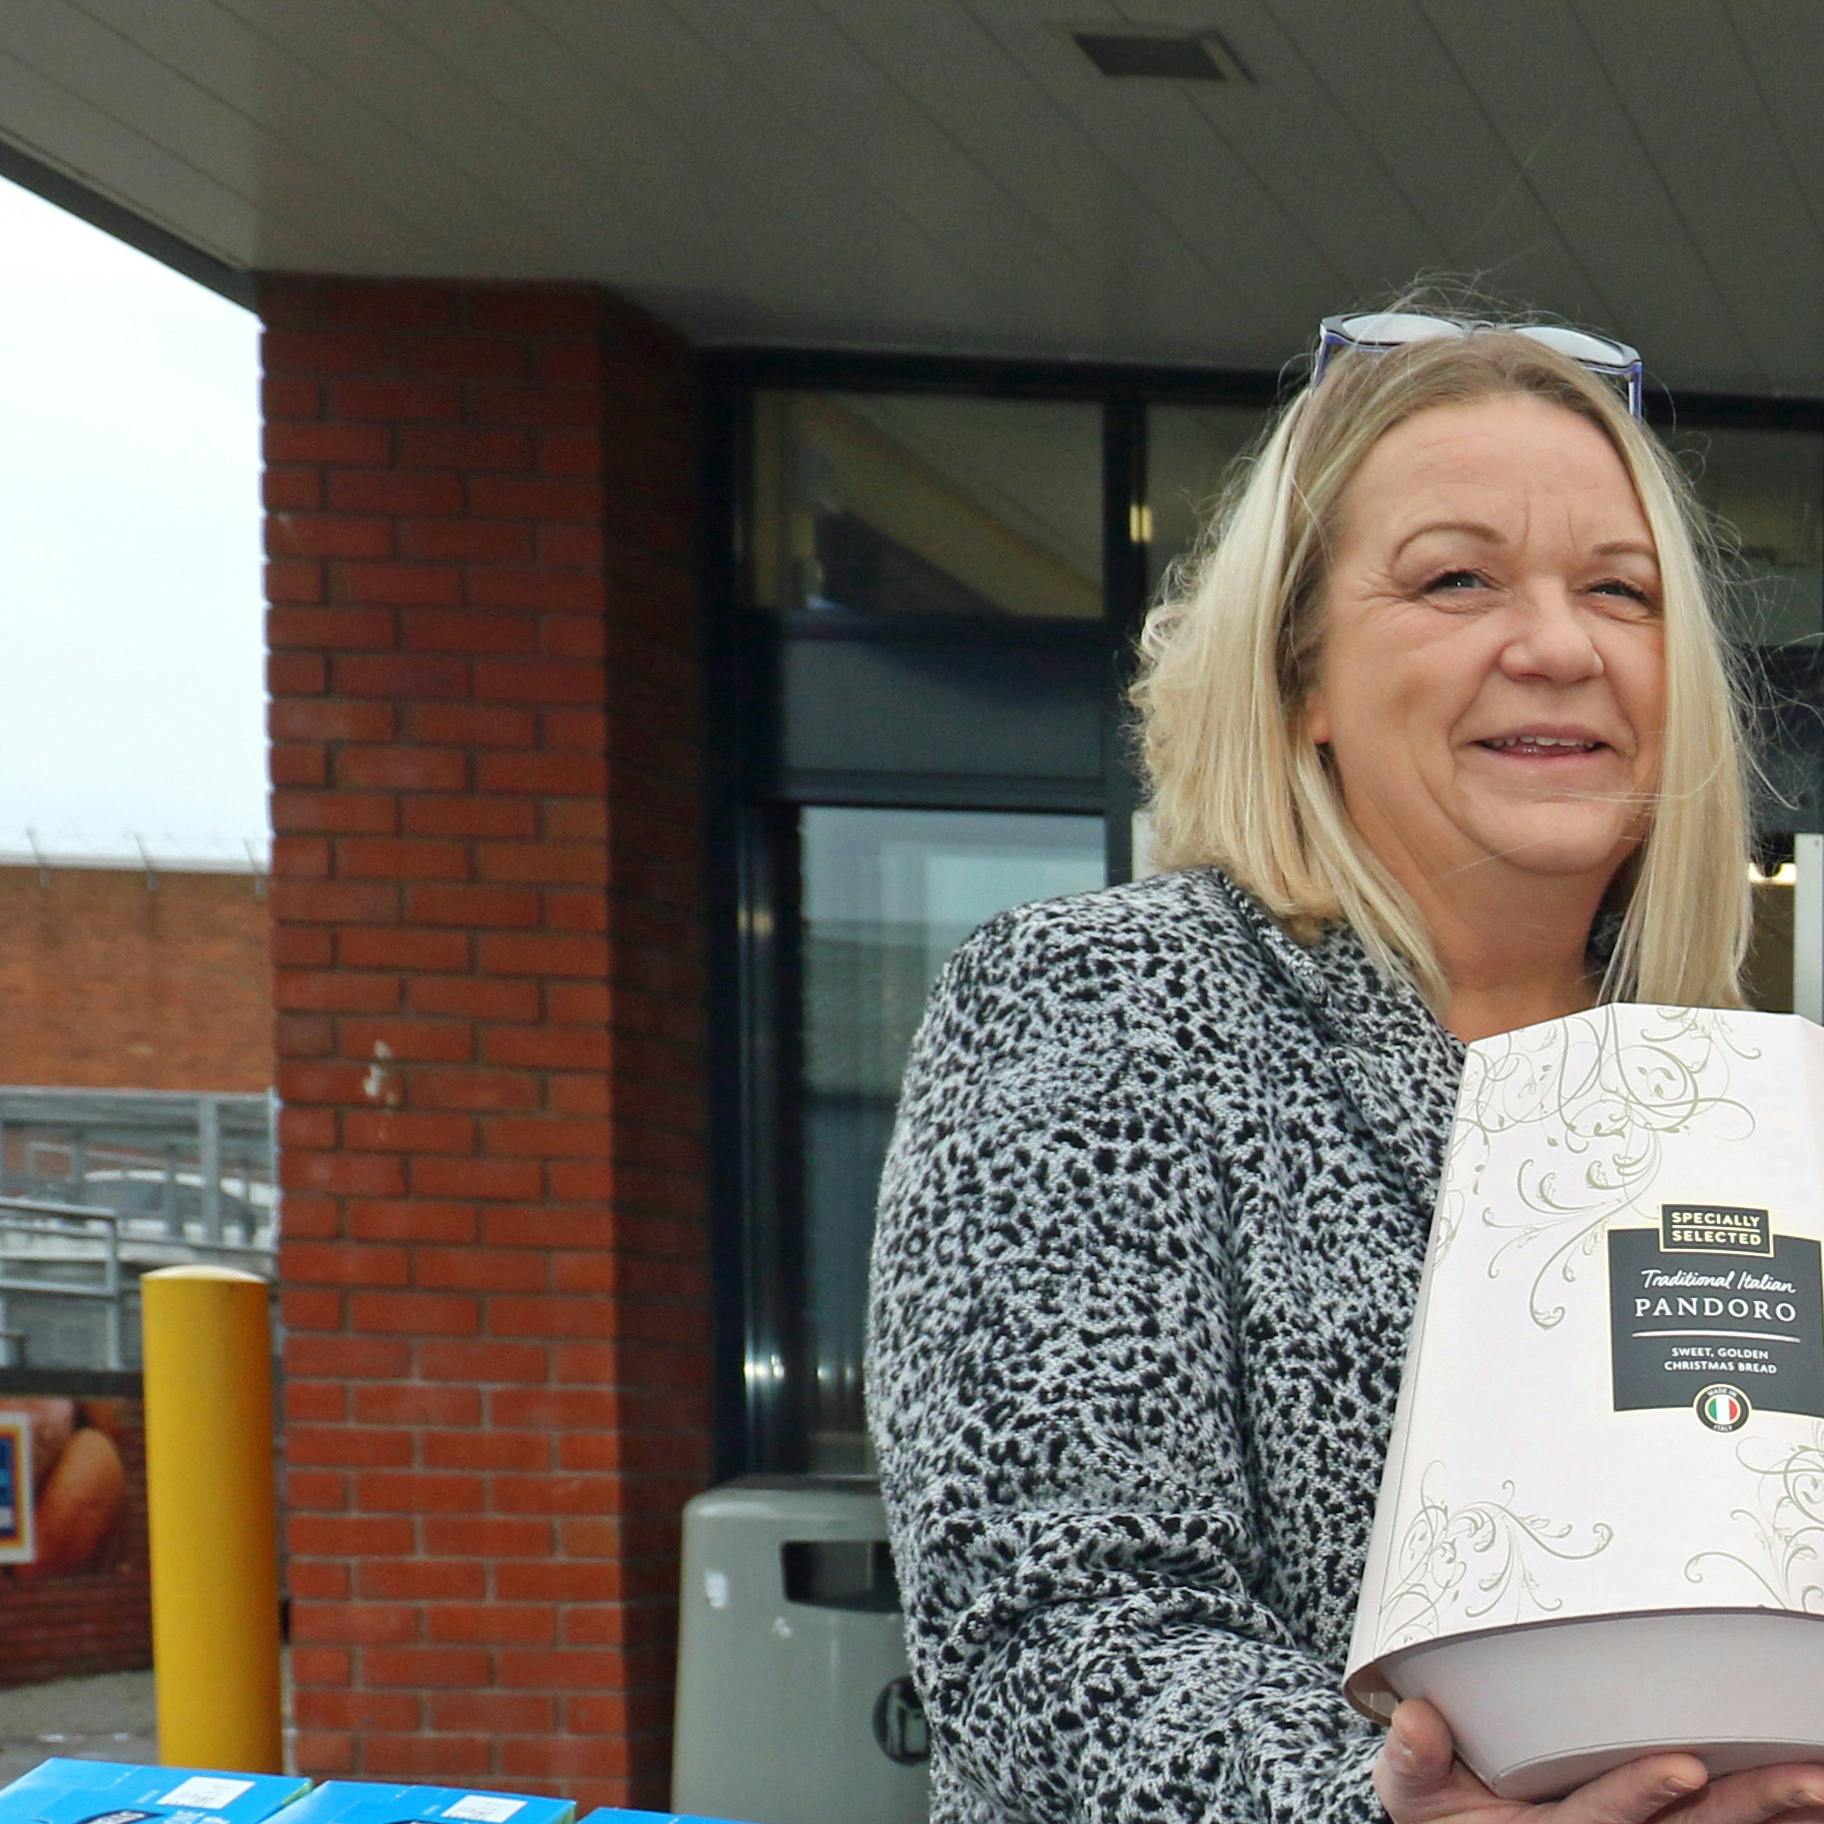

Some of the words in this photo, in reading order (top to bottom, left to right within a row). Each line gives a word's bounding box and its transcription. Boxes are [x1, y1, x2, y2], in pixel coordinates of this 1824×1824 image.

[1671, 1211, 1760, 1228] SPECIALLY
[1671, 1229, 1762, 1246] SELECTED
[1641, 1269, 1735, 1290] Traditional
[1737, 1277, 1797, 1294] Italian
[1634, 1297, 1797, 1323] PANDORO
[1717, 1347, 1769, 1360] GOLDEN
[1664, 1360, 1734, 1372] CHRISTMAS
[1738, 1361, 1777, 1374] BREAD
